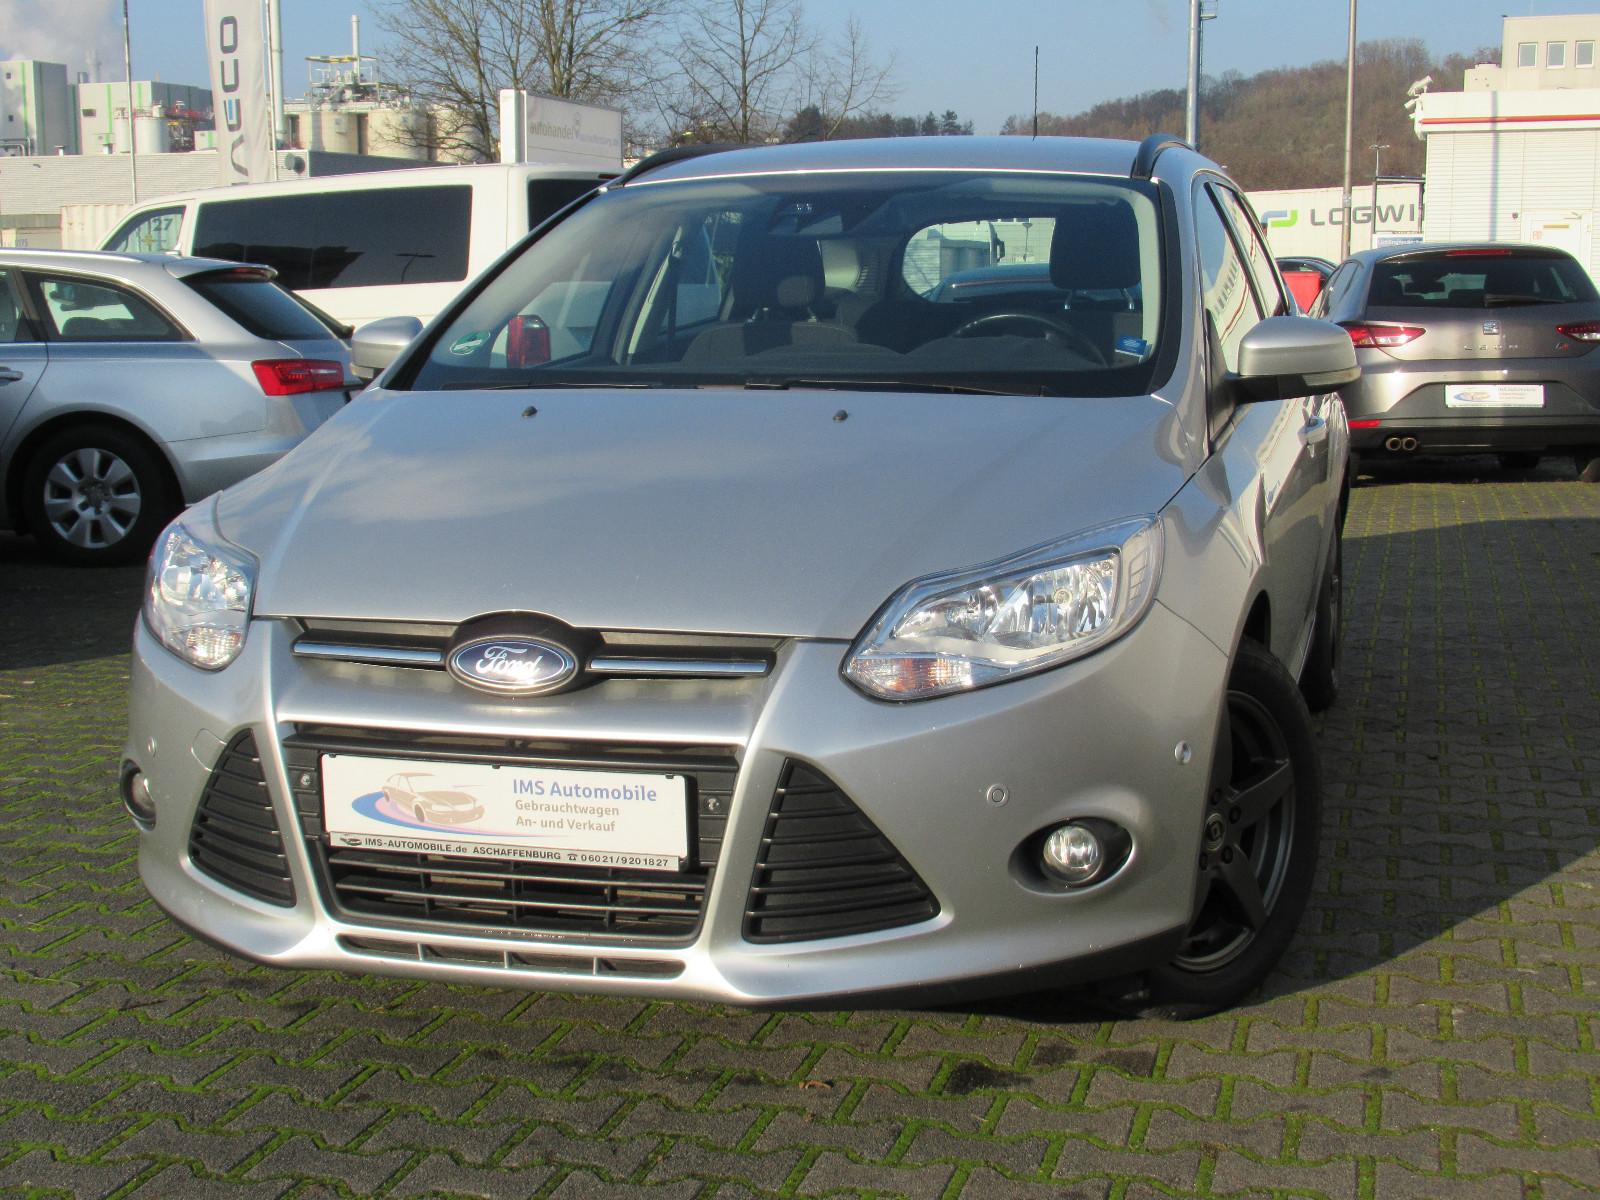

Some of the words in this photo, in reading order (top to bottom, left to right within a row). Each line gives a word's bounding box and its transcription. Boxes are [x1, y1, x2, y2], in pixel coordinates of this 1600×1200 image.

[152, 218, 174, 232] 27
[1310, 203, 1425, 226] LOGWI
[475, 645, 543, 675] Ford
[513, 779, 545, 796] IMS
[550, 781, 657, 802] Automobile
[515, 799, 620, 818] Gebrauchtwagen
[516, 815, 537, 827] An-
[540, 818, 564, 830] und
[567, 818, 616, 832] Verkauf
[364, 837, 468, 854] IMS-AUTOMOBILE.de
[472, 846, 561, 860] ASCHAFFENBURG
